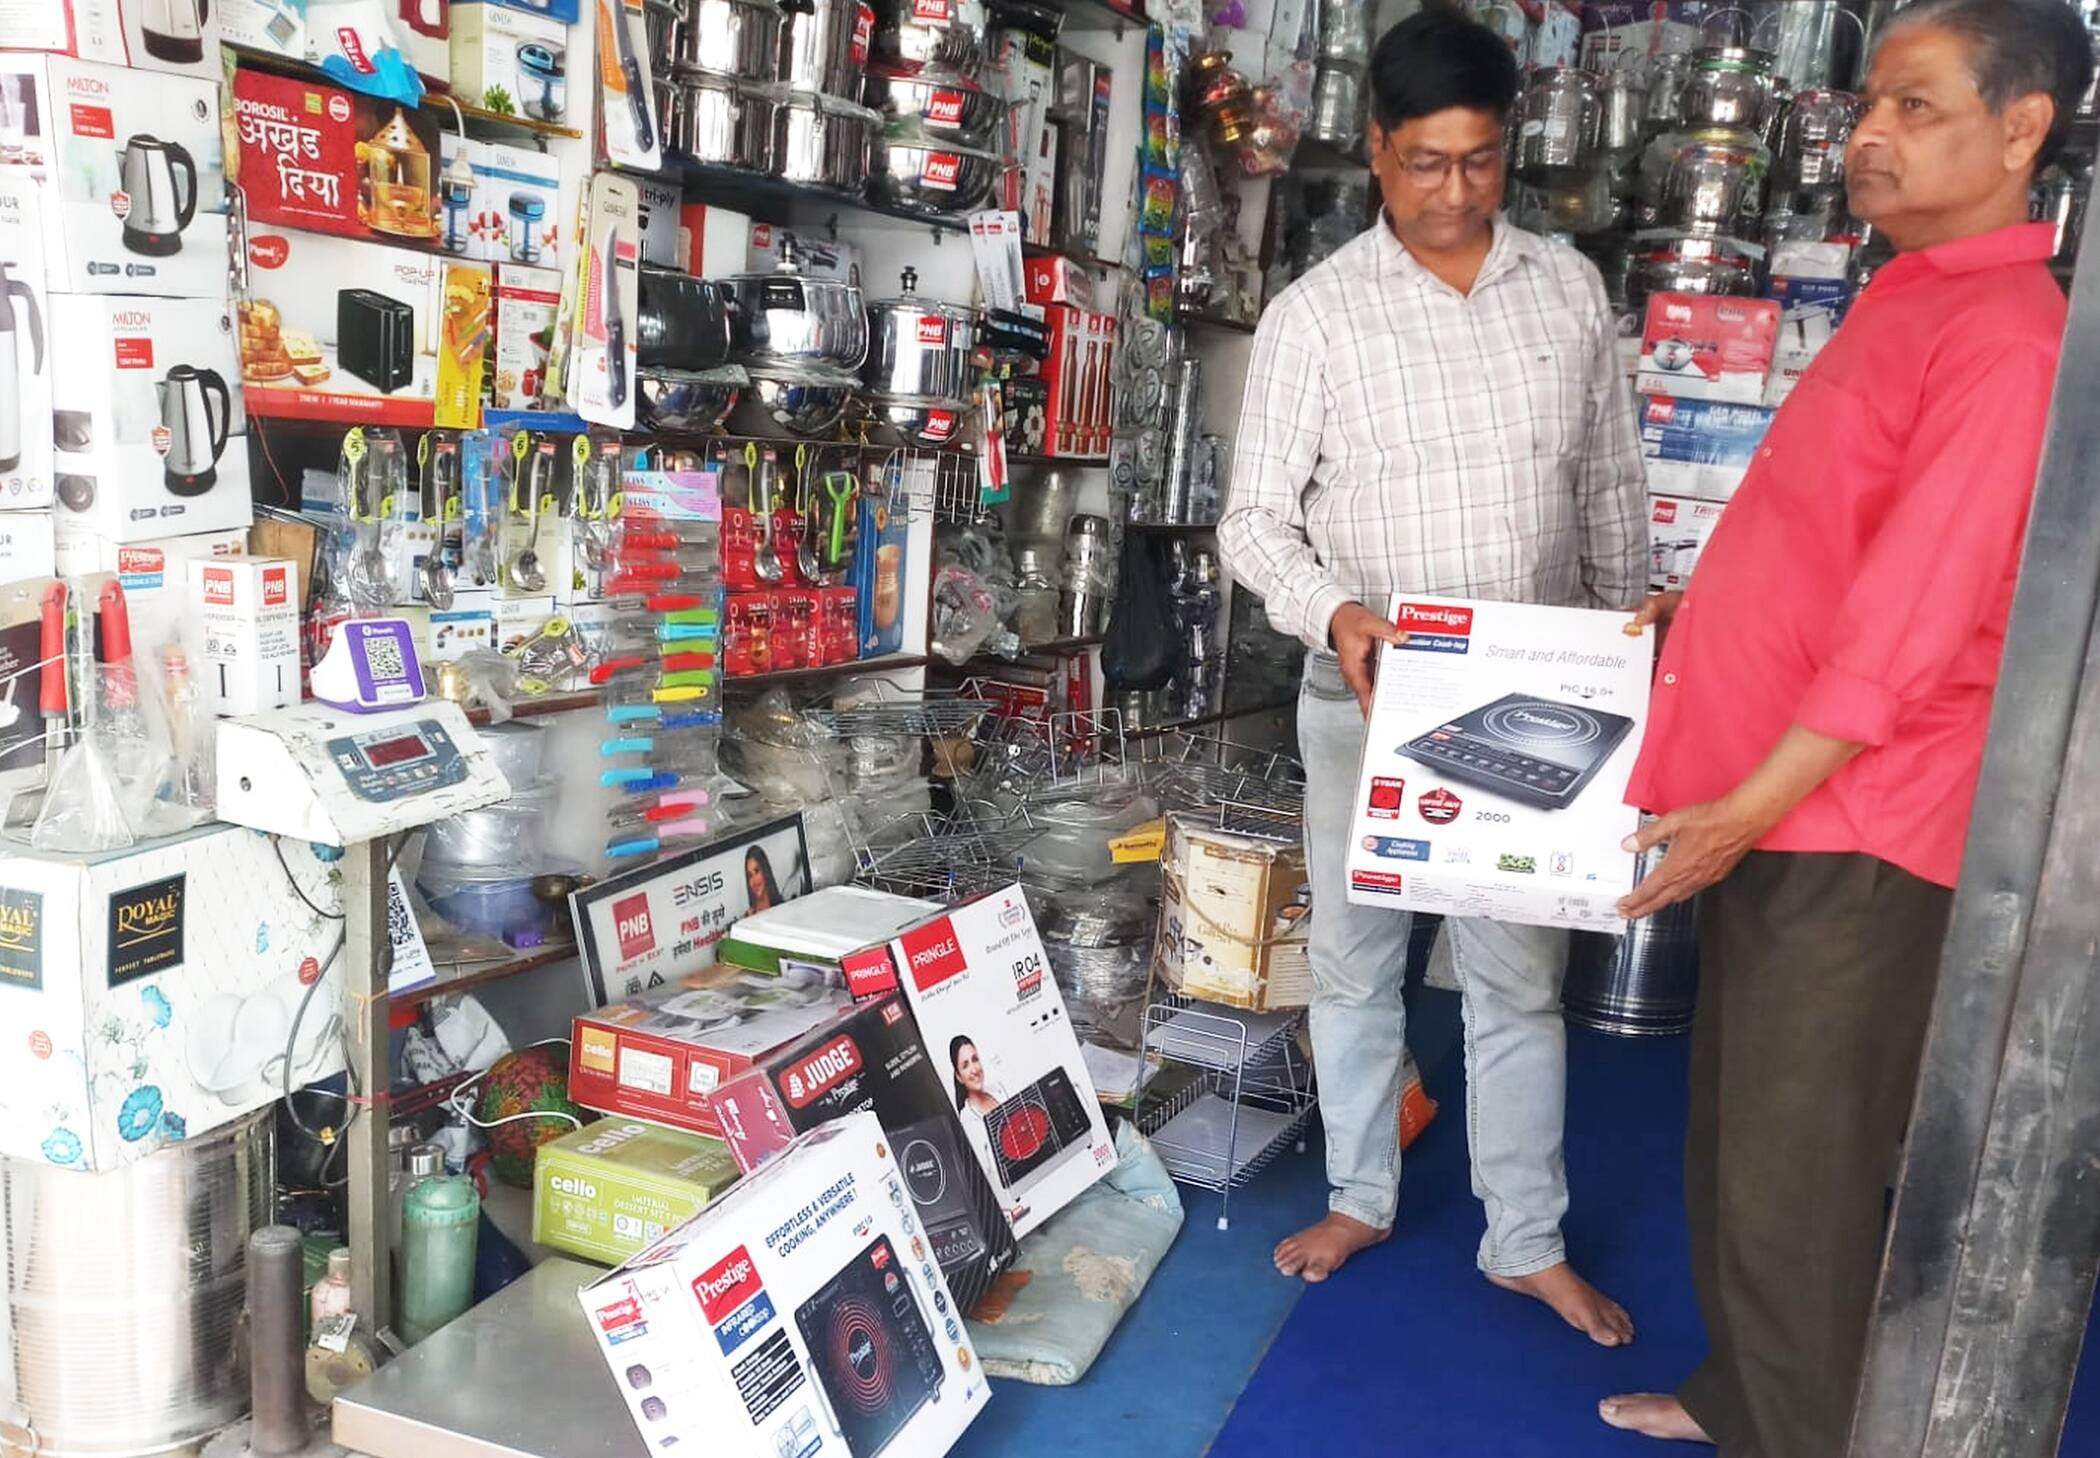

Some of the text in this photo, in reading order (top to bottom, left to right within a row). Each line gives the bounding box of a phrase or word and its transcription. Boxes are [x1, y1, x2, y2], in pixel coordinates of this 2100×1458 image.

[67, 77, 109, 94] MILTON
[235, 98, 288, 121] BOROSIL
[931, 100, 960, 115] PNB
[239, 115, 321, 159] अखंड
[276, 153, 340, 207] दिया
[928, 161, 956, 177] PNB
[112, 312, 151, 326] MILTON
[917, 323, 943, 336] PNB
[204, 582, 231, 593] PNB
[265, 582, 285, 594] PNB
[1401, 605, 1469, 627] Prestige
[1485, 645, 1627, 669] Smart and Affordable
[1475, 811, 1511, 824] 2000
[673, 871, 724, 907] ENSIS
[0, 903, 34, 925] YAL
[118, 894, 177, 933] ROYAL
[145, 909, 176, 926] MAGIC
[619, 912, 650, 942] PNB
[912, 939, 957, 969] PRINGLE
[851, 964, 889, 982] PRINGLE
[584, 1043, 613, 1058] cello
[804, 1041, 854, 1091] JUDGE
[577, 1124, 647, 1154] cello
[551, 1175, 597, 1199] cello
[765, 1206, 813, 1249] EFFORTLESS
[816, 1171, 857, 1208] VERSATILE
[778, 1222, 817, 1258] COOKING,
[695, 1257, 752, 1306] Prestige
